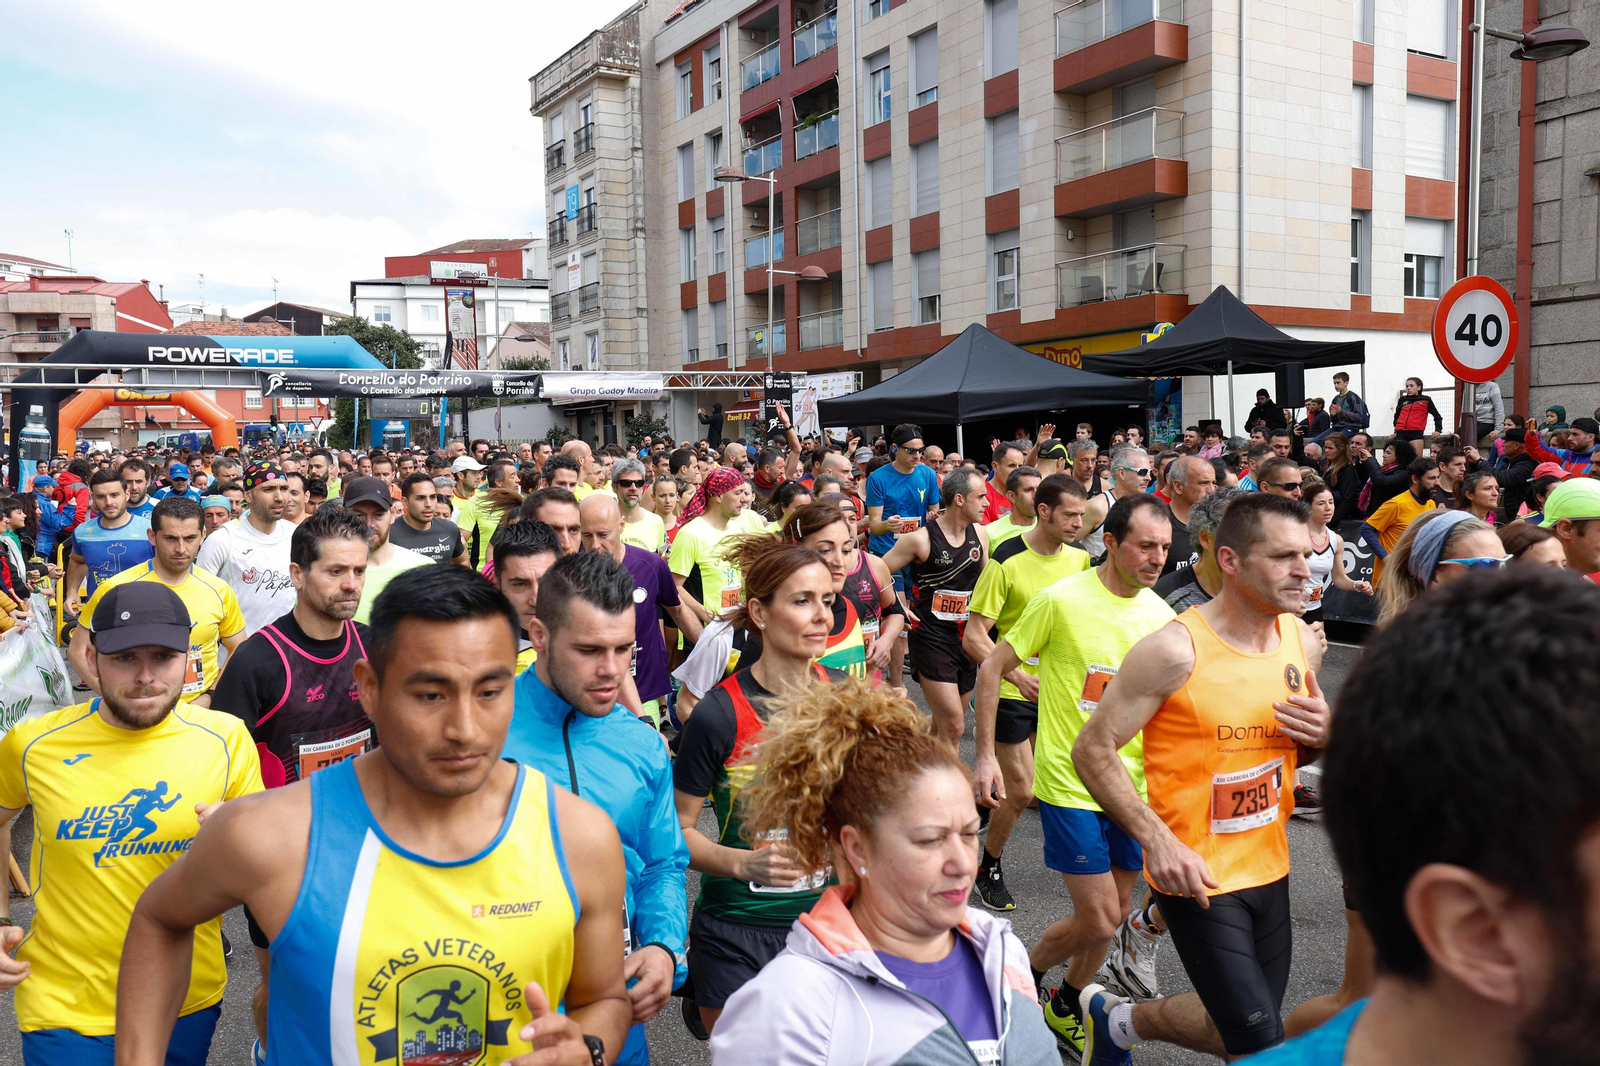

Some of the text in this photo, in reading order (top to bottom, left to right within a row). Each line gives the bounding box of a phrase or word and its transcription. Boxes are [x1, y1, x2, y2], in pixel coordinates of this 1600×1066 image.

[568, 193, 577, 212] 19
[1454, 314, 1502, 347] 40
[148, 346, 294, 364] POWERADE
[1046, 350, 1080, 366] Dino
[339, 373, 472, 386] Concello do Porriño
[370, 386, 402, 394] Concello
[405, 386, 415, 394] do
[416, 386, 446, 396] Deporte
[506, 386, 534, 394] Porriño
[570, 387, 596, 396] Grupo
[598, 387, 626, 396] Godoy
[420, 402, 428, 414] 0
[941, 599, 963, 614] 602
[306, 692, 325, 702] ZICO
[346, 736, 362, 744] PORRIÑO
[1226, 774, 1248, 782] CARREIRA
[1232, 782, 1269, 818] 239
[74, 804, 135, 823] JUST
[56, 816, 131, 840] KEEP
[105, 837, 196, 858] RUNNING
[489, 900, 542, 915] REDONET
[357, 938, 522, 1028] ATLETAS VETERANOS
